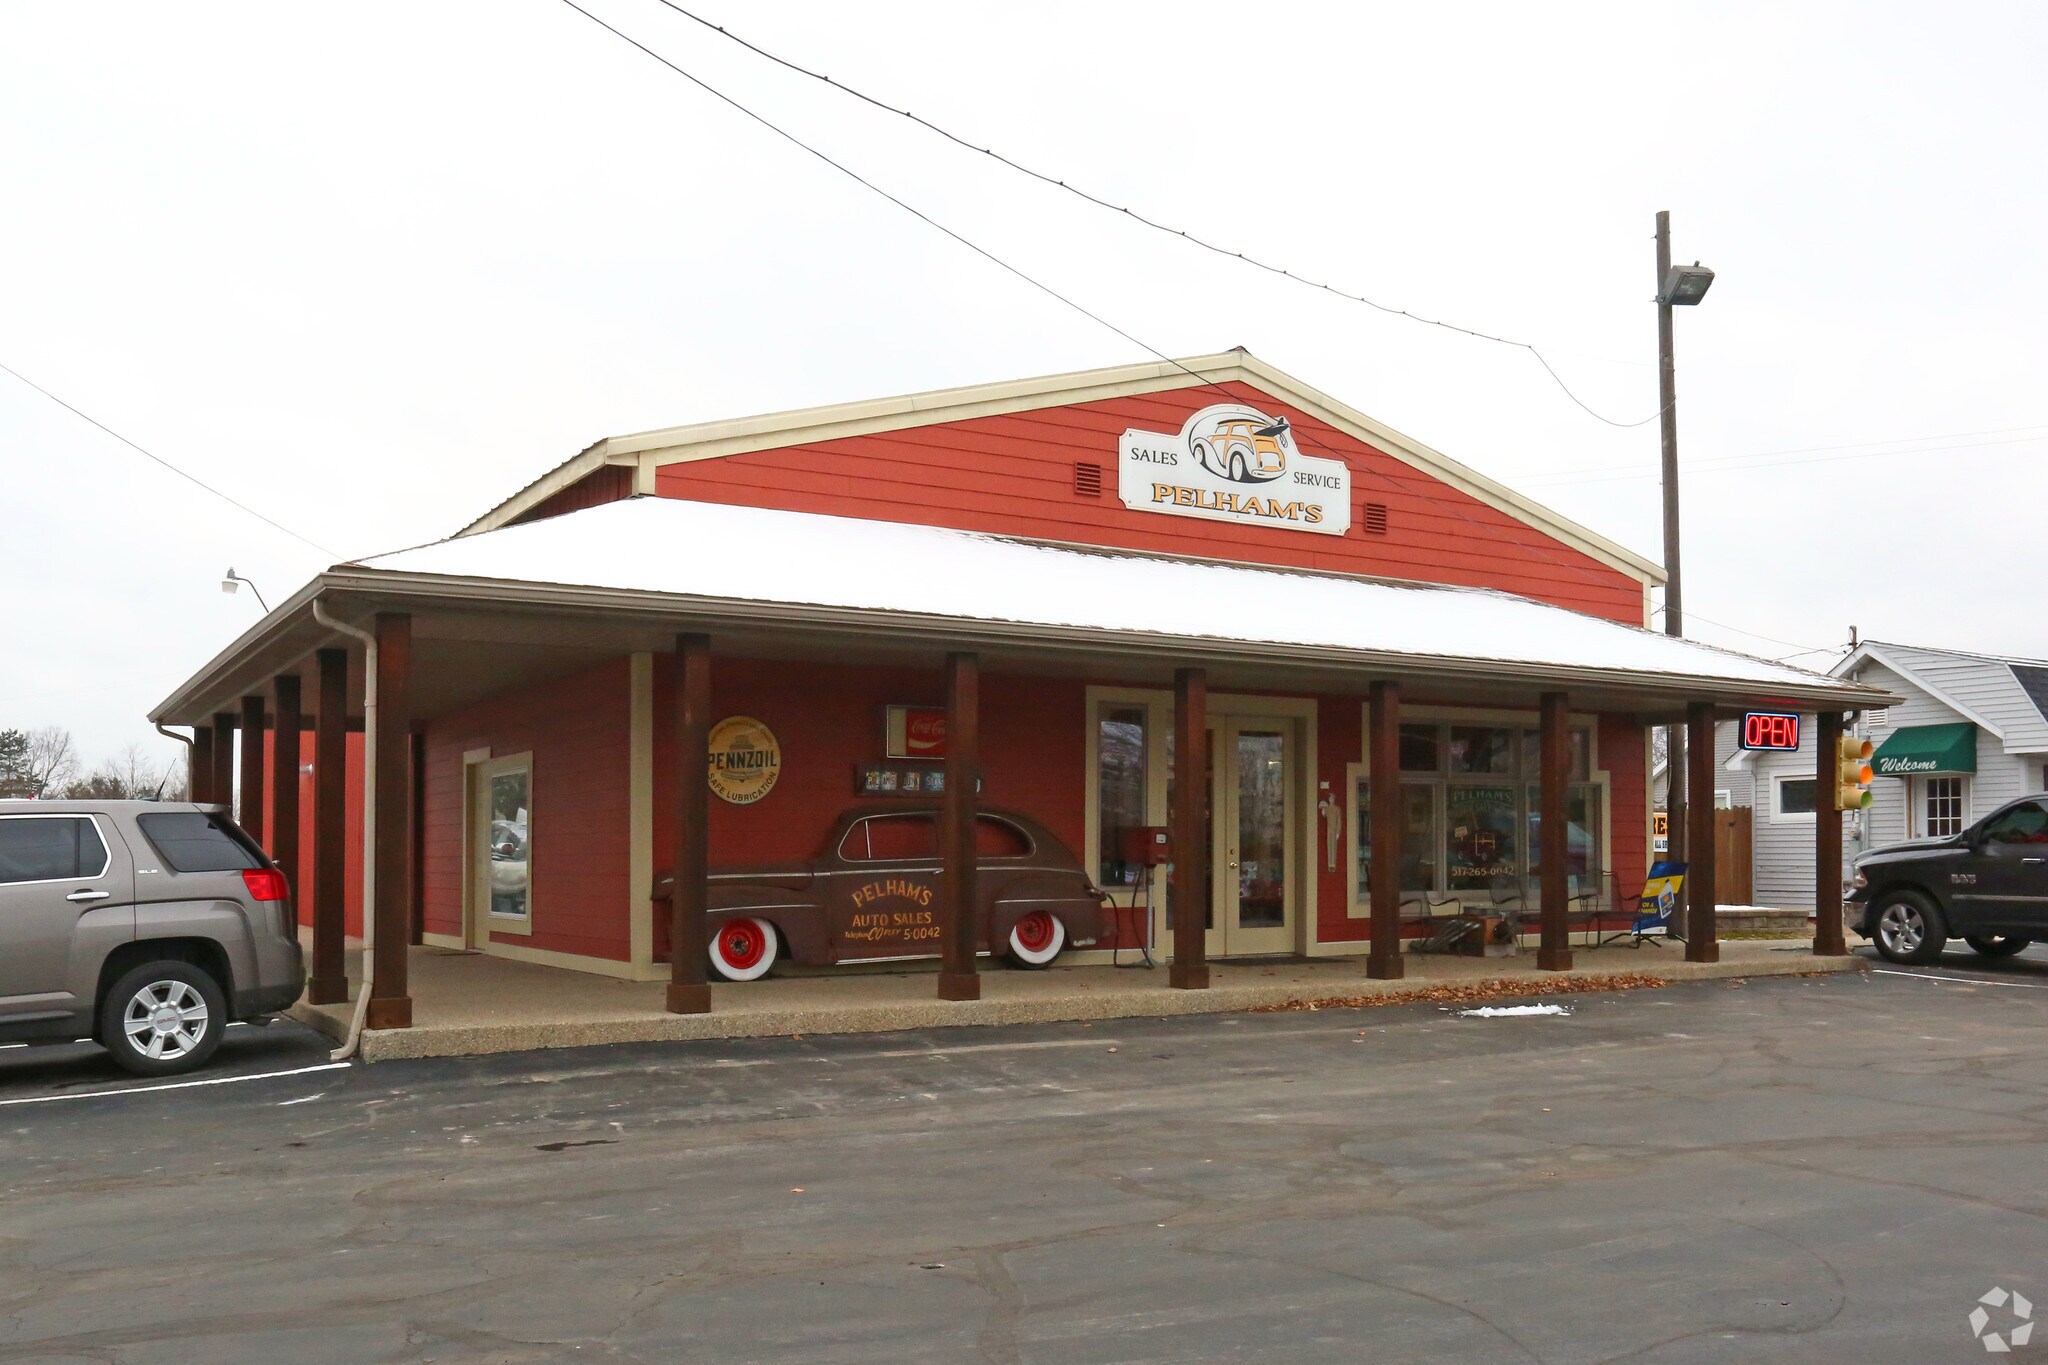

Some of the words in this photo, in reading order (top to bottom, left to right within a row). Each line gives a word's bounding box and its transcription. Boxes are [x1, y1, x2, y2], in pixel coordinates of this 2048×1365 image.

[1131, 447, 1178, 466] SALES
[1293, 471, 1341, 489] SERVICE
[1151, 482, 1324, 524] PELHAM'S
[1747, 715, 1796, 746] OPEN
[708, 750, 777, 770] PENNZOIL
[1880, 757, 1938, 772] Welcome
[708, 773, 726, 794] SAFE
[727, 771, 777, 801] LUBRICATION
[851, 879, 933, 908] PELHAM'S
[852, 913, 889, 927] AUTO
[893, 911, 932, 925] SALES
[156, 1016, 176, 1024] GMC
